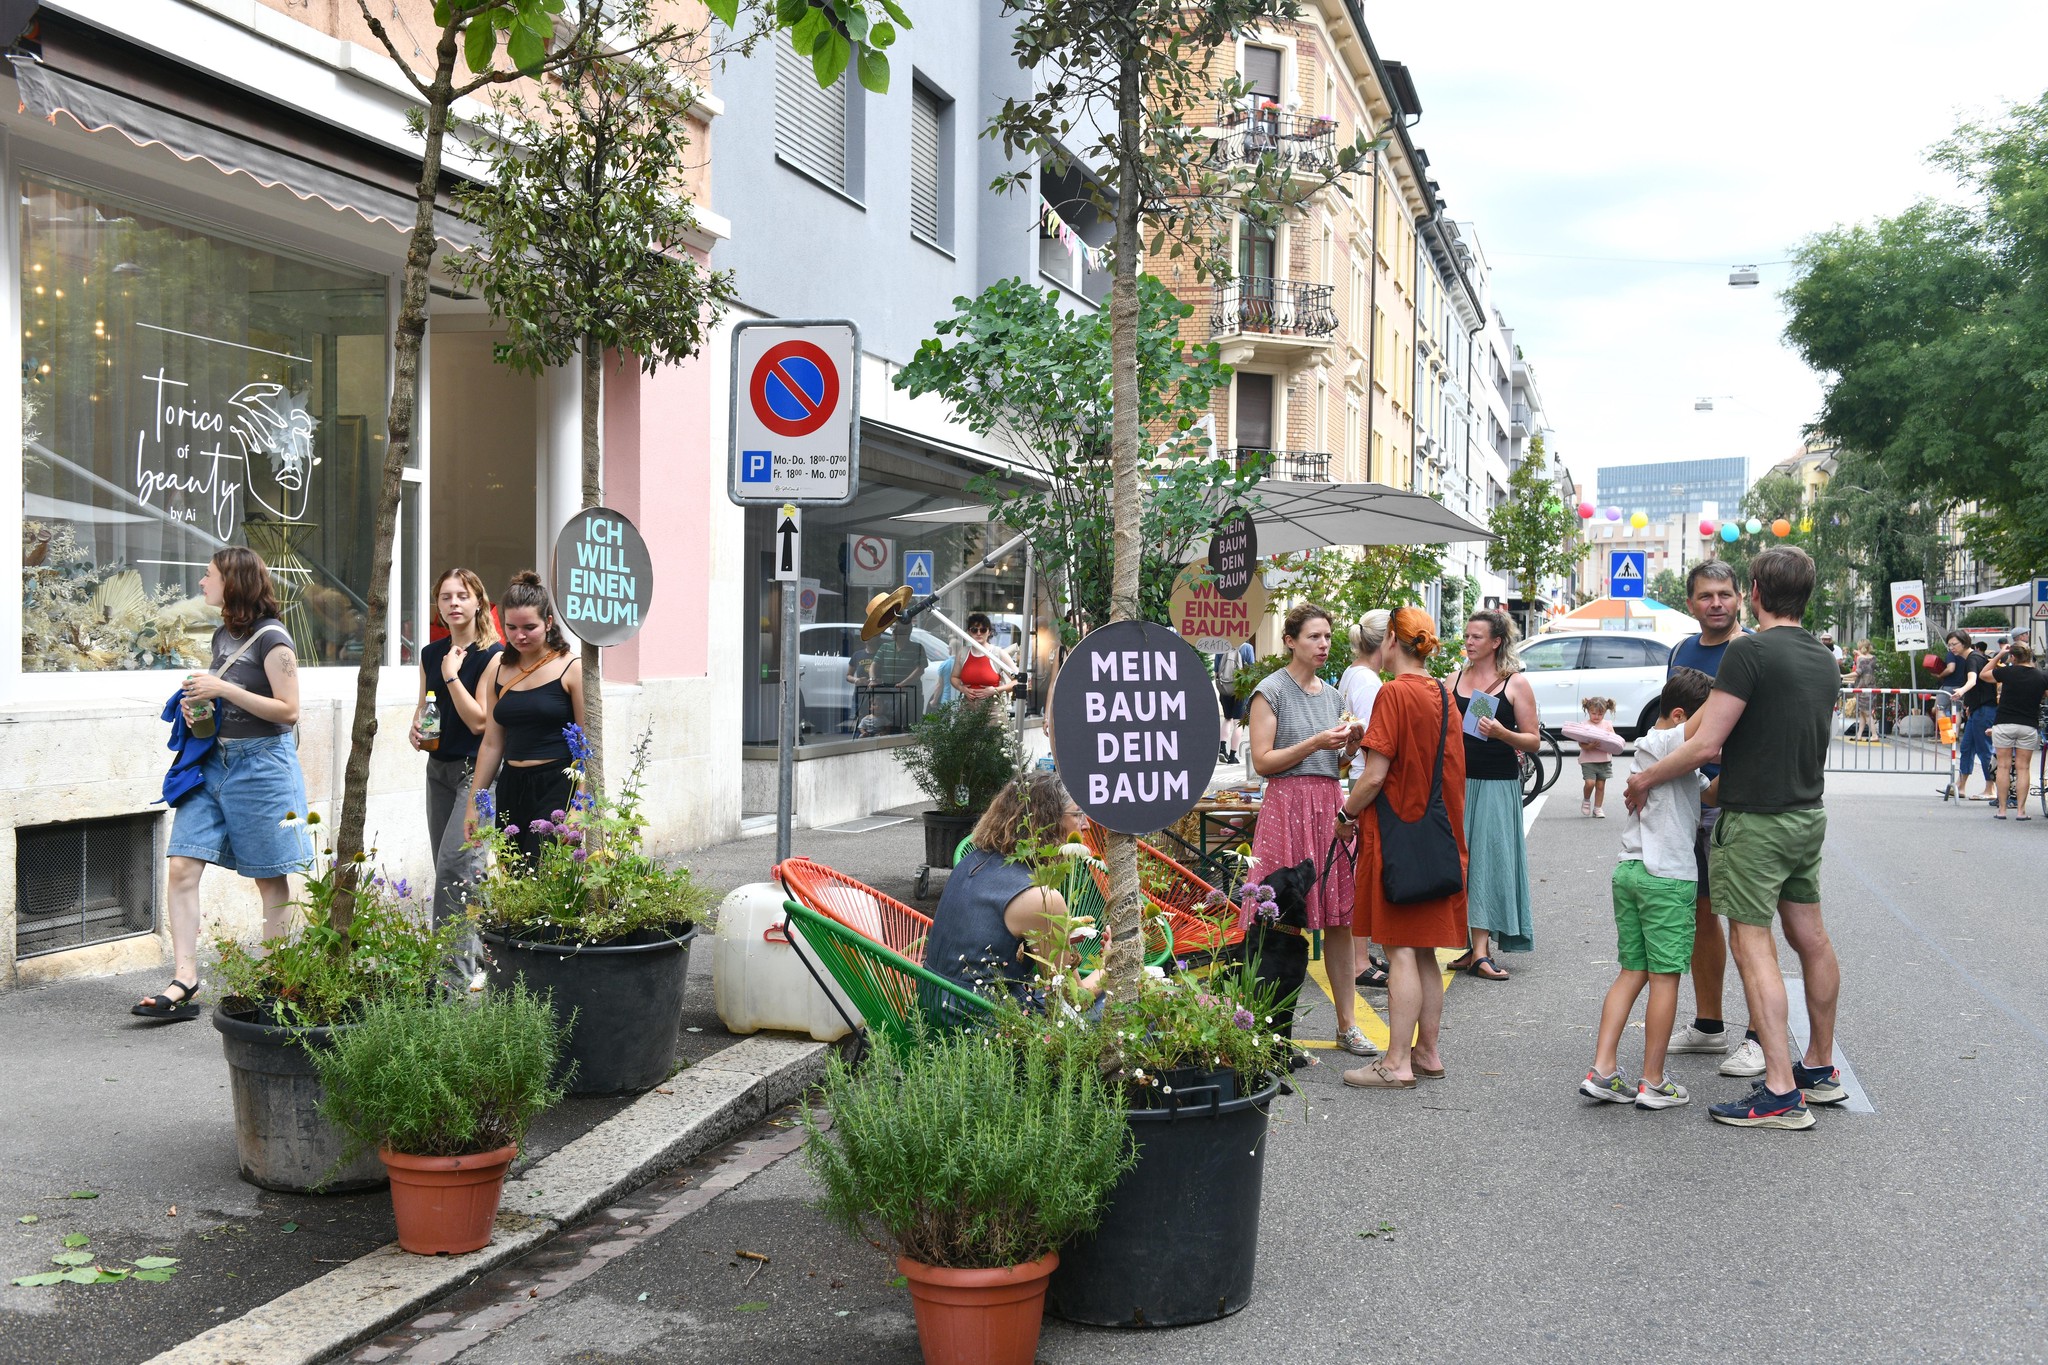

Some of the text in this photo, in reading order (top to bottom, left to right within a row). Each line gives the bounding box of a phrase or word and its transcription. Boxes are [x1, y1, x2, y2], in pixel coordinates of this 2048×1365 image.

[142, 367, 223, 443] Torico
[177, 444, 190, 459] of
[750, 455, 765, 478] P
[773, 469, 782, 479] Fr.
[811, 469, 827, 479] Mo.
[137, 442, 243, 542] beauty
[170, 506, 196, 523] by Ai
[585, 516, 623, 546] ICH
[1219, 534, 1247, 555] BAUM
[576, 542, 631, 574] WILL
[1221, 552, 1245, 571] DEIN
[570, 568, 636, 601] EINEN
[1219, 570, 1247, 590] BAUM
[566, 594, 639, 627] BAUM!
[1185, 601, 1248, 619] EINEN
[1181, 619, 1250, 637] BAUM!
[1091, 651, 1178, 682] MEIN
[1085, 690, 1186, 723] BAUM
[1097, 731, 1178, 764] DEIN
[1088, 770, 1189, 805] BAUM
